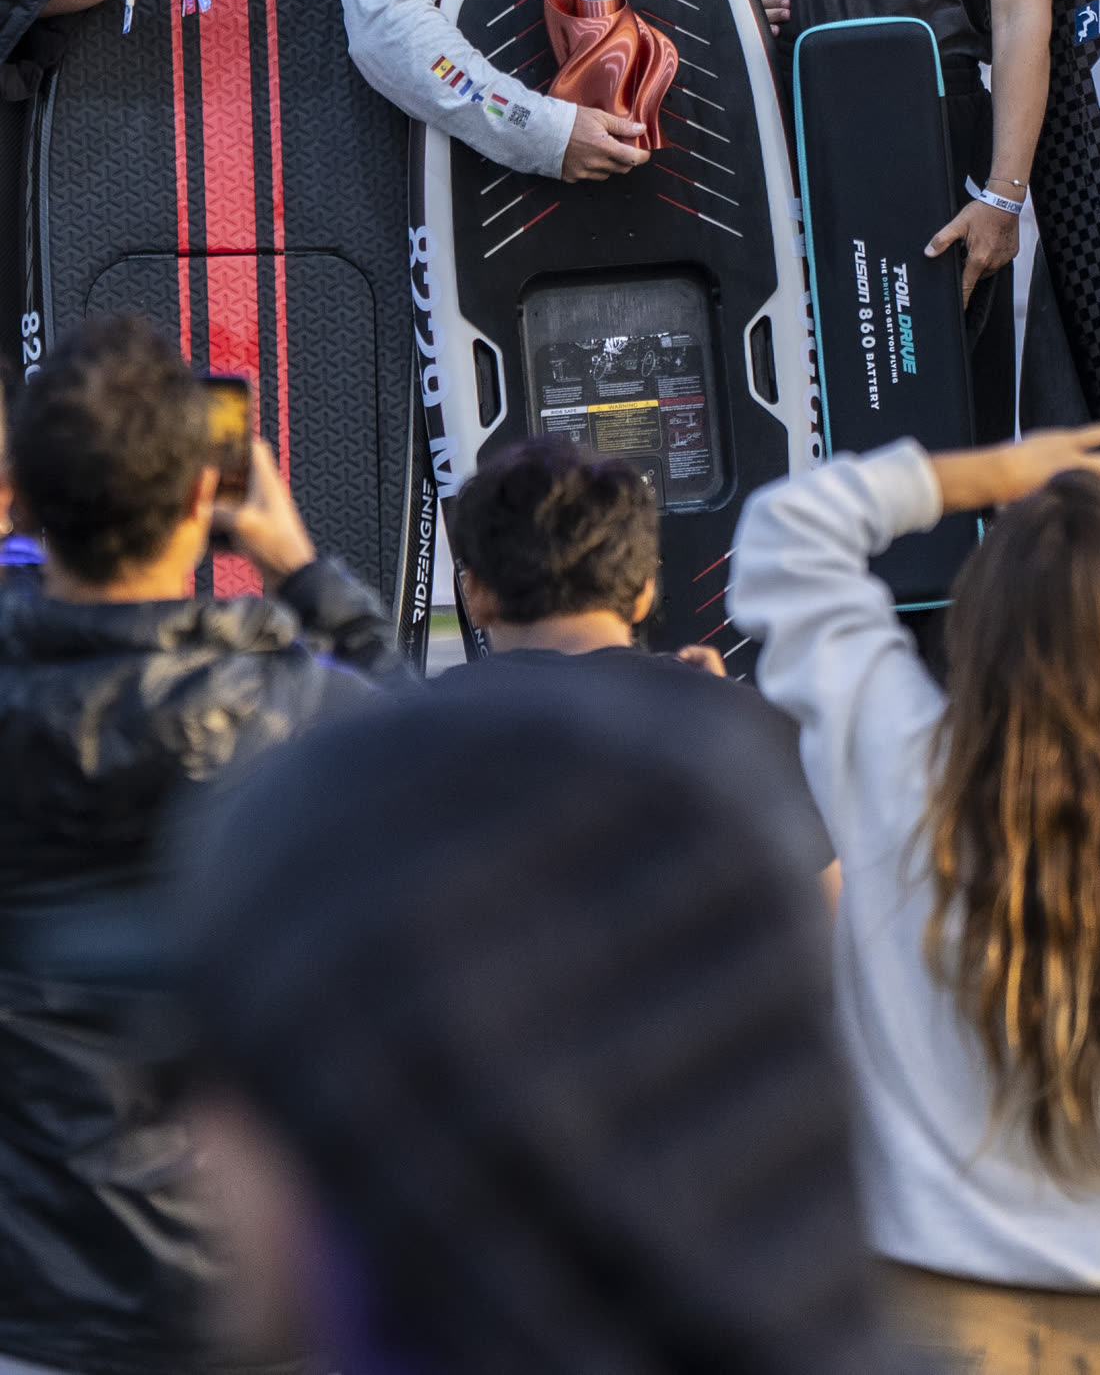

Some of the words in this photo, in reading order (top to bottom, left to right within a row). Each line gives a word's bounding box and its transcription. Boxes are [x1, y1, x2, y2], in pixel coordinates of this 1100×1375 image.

[880, 257, 888, 275] THE
[882, 276, 891, 302] DRIVE
[884, 303, 892, 315] TO
[886, 317, 894, 334] GET
[887, 335, 896, 353] YOU
[889, 354, 899, 384] FLYING
[865, 353, 880, 410] BATTERY
[608, 402, 638, 410] WARNING
